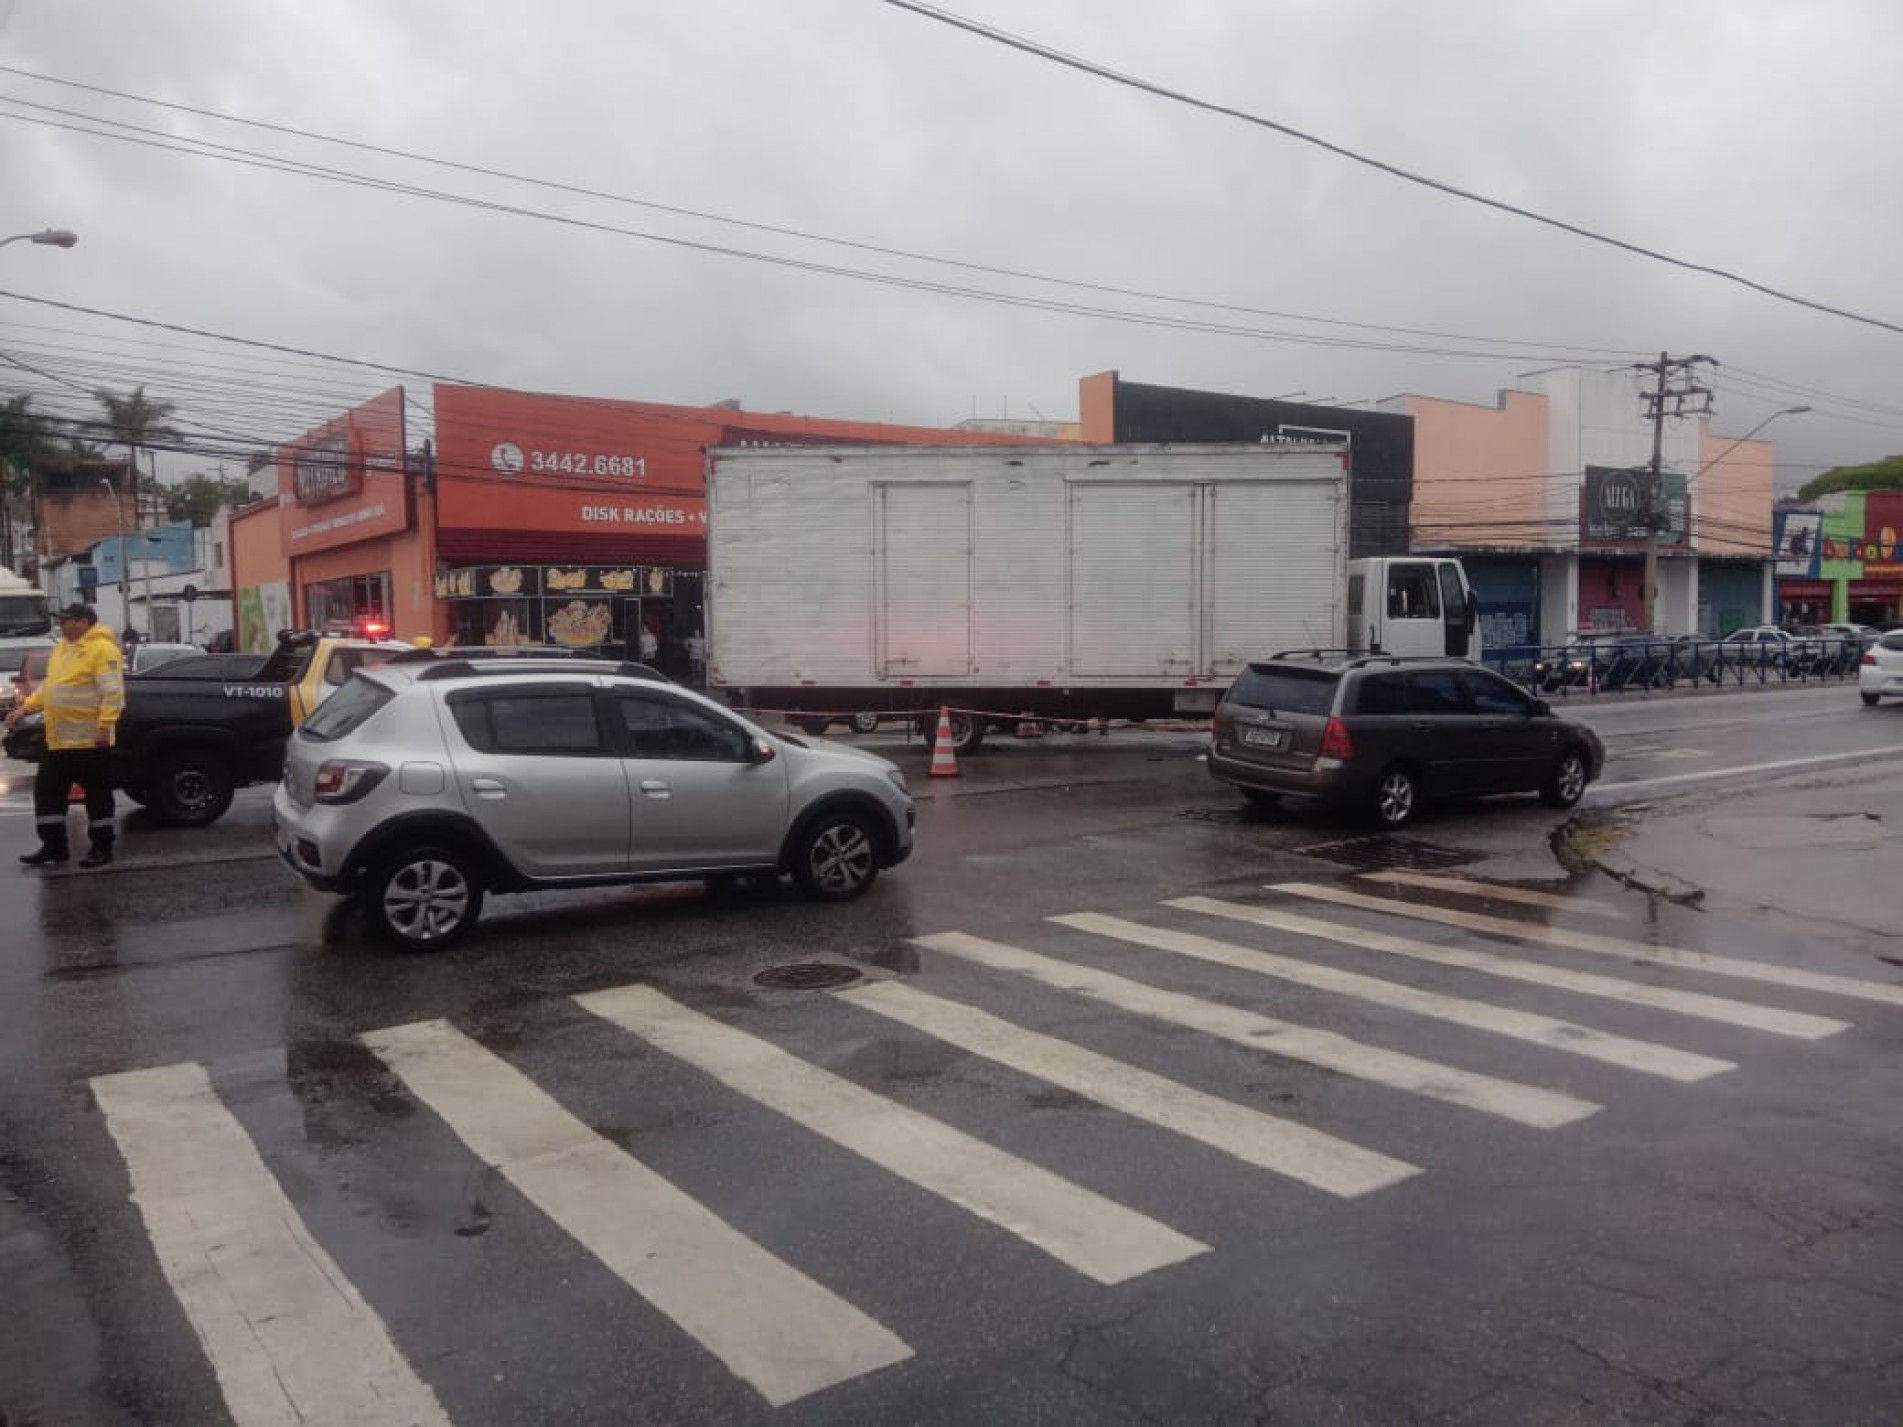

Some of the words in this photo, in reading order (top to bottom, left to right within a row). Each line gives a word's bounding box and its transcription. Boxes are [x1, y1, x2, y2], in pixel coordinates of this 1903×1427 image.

[530, 450, 645, 477] 3442.6681
[580, 505, 621, 522] DISK
[623, 504, 685, 525] RAÇÕES
[223, 686, 283, 698] VT-1010
